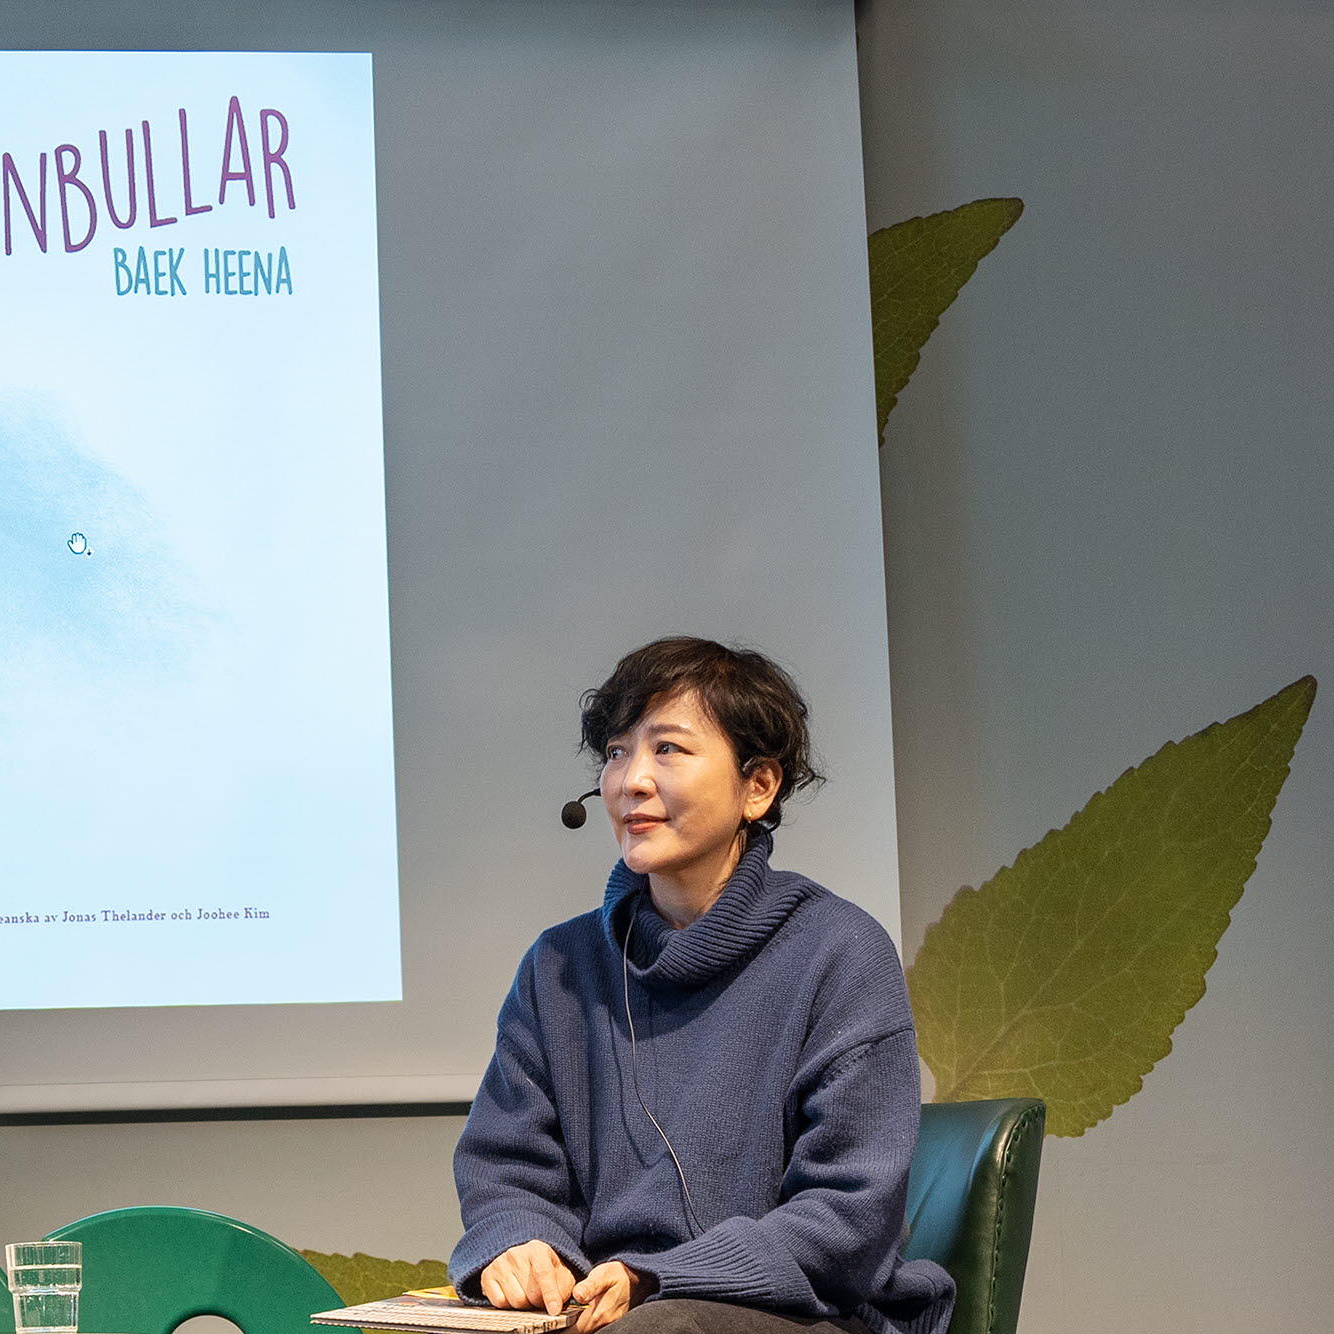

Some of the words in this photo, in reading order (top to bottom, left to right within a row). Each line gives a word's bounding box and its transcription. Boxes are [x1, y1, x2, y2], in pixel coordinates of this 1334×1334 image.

[113, 246, 187, 297] BAEK
[203, 246, 293, 297] HEENA
[44, 914, 58, 923] av
[62, 910, 97, 922] Jonas
[101, 910, 166, 922] Thelander
[170, 909, 192, 920] och
[197, 908, 240, 919] Joohee
[244, 907, 270, 919] Kim
